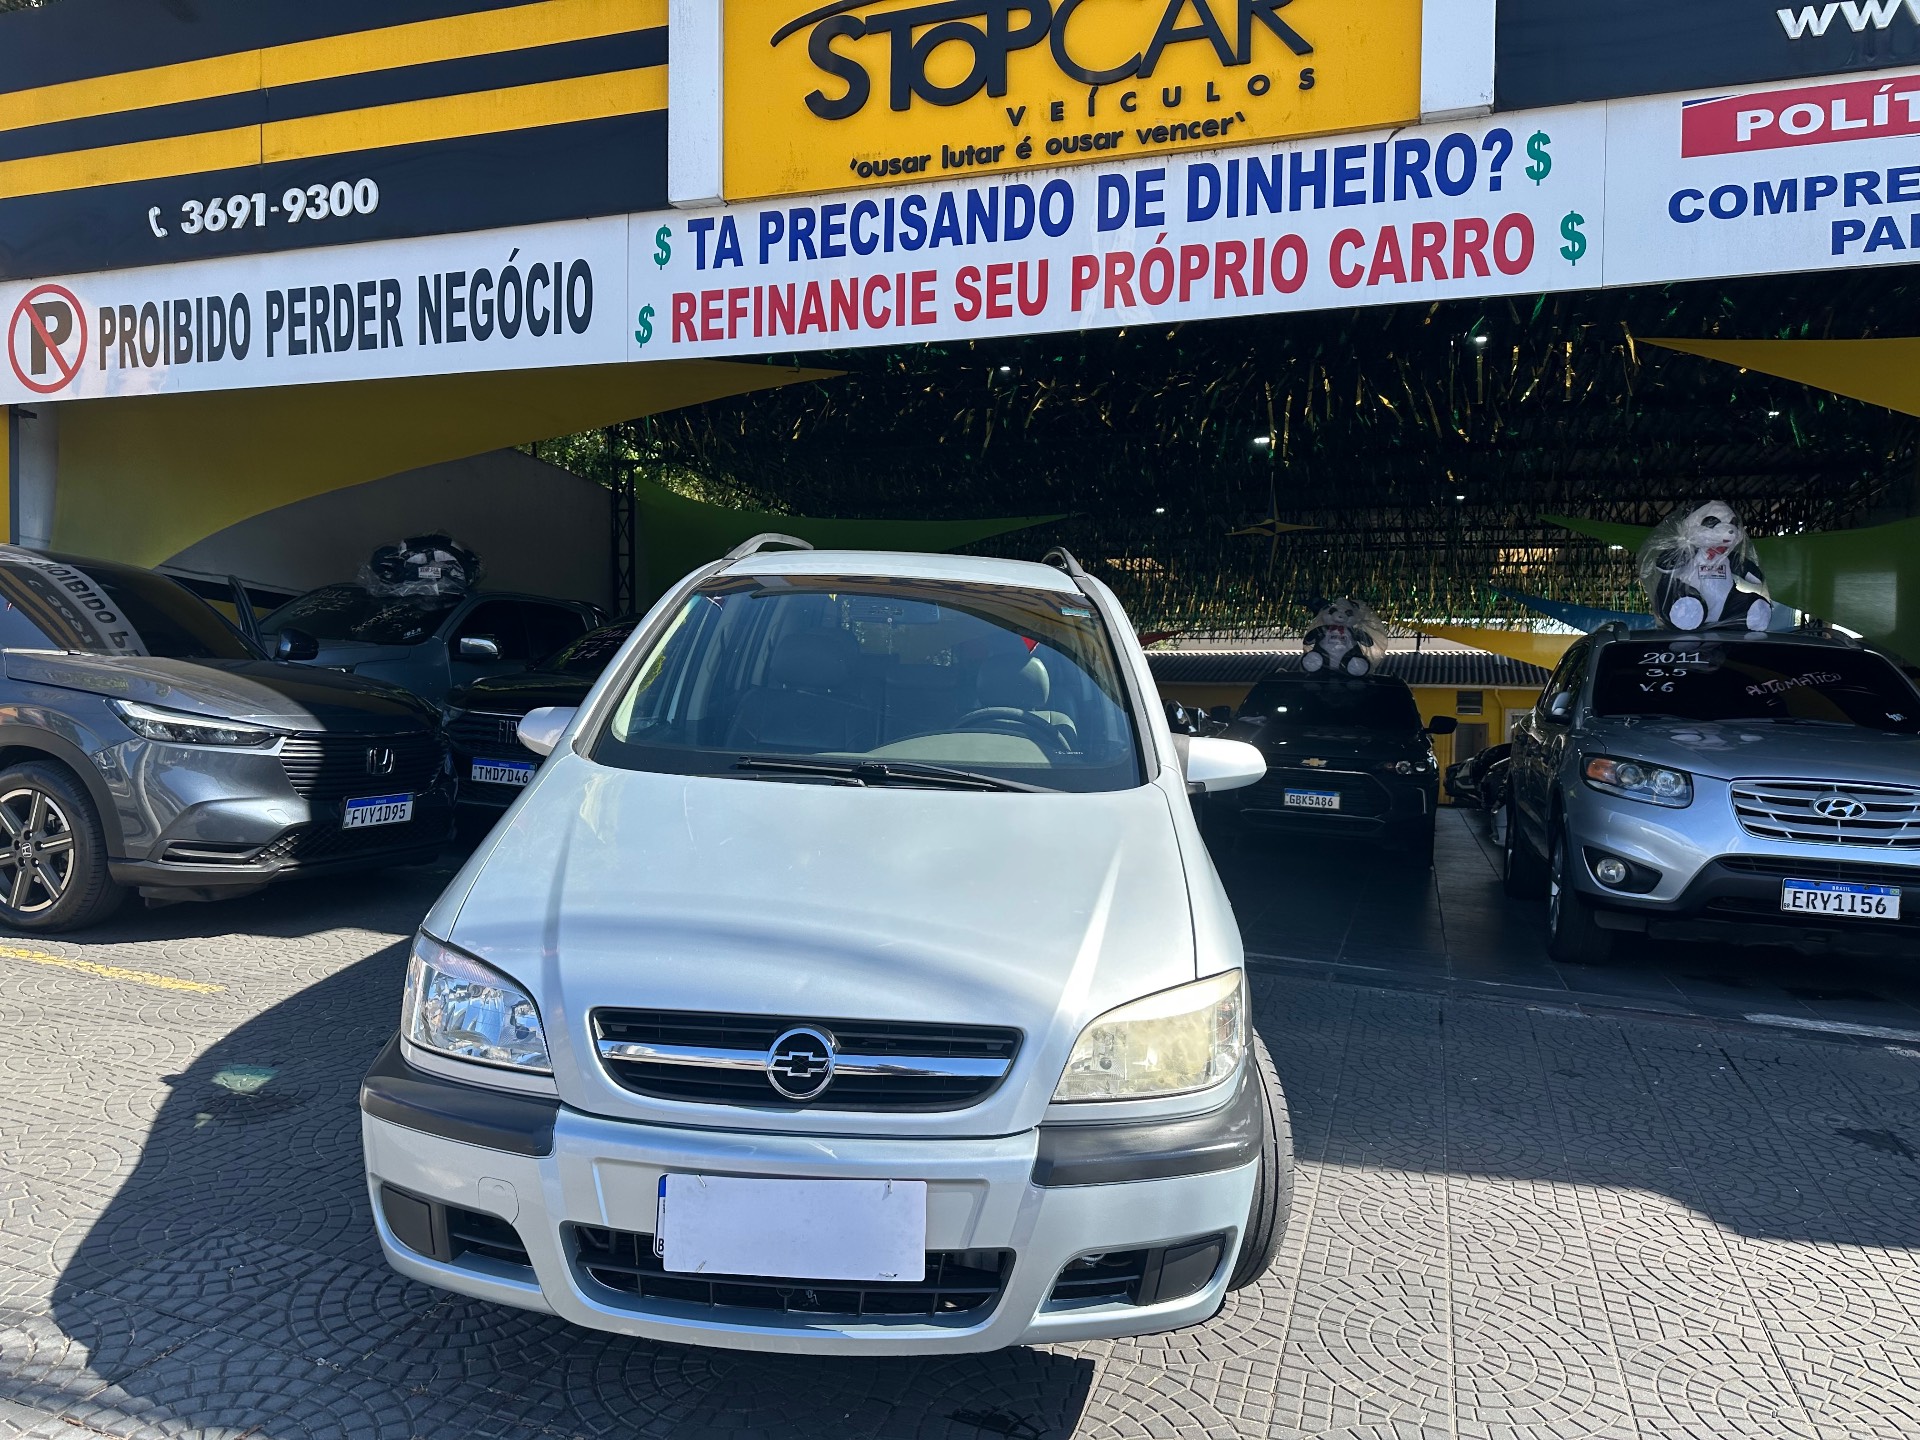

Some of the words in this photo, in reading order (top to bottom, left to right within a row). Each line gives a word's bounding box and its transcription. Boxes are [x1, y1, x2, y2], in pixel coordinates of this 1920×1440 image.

[1776, 0, 1920, 39] ww
[1006, 68, 1315, 127] VEÍCULOS
[941, 141, 1005, 168] lutar
[1015, 136, 1032, 160] é
[1045, 128, 1124, 155] ousar
[181, 178, 379, 235] 3691-9300
[687, 214, 743, 271] TA
[760, 178, 1075, 264] PRECISANDO
[1098, 167, 1166, 232] DE
[1187, 128, 1514, 222] DINHEIRO?
[672, 265, 938, 343] REFINANCIE
[954, 259, 1049, 322] SEU
[1072, 231, 1308, 315] PRÓPRIO
[1329, 212, 1535, 289] CARRO
[99, 292, 251, 371] PROIBIDO
[266, 278, 402, 358] PERDER
[418, 247, 594, 346] NEGÓCIO
[1637, 652, 1710, 665] 2011
[1646, 668, 1688, 677] 3.5
[478, 766, 529, 784] TMD7D46
[351, 803, 407, 826] FVY1D95
[1289, 794, 1334, 807] GBK5A86
[1791, 890, 1888, 915] ERY1I56
